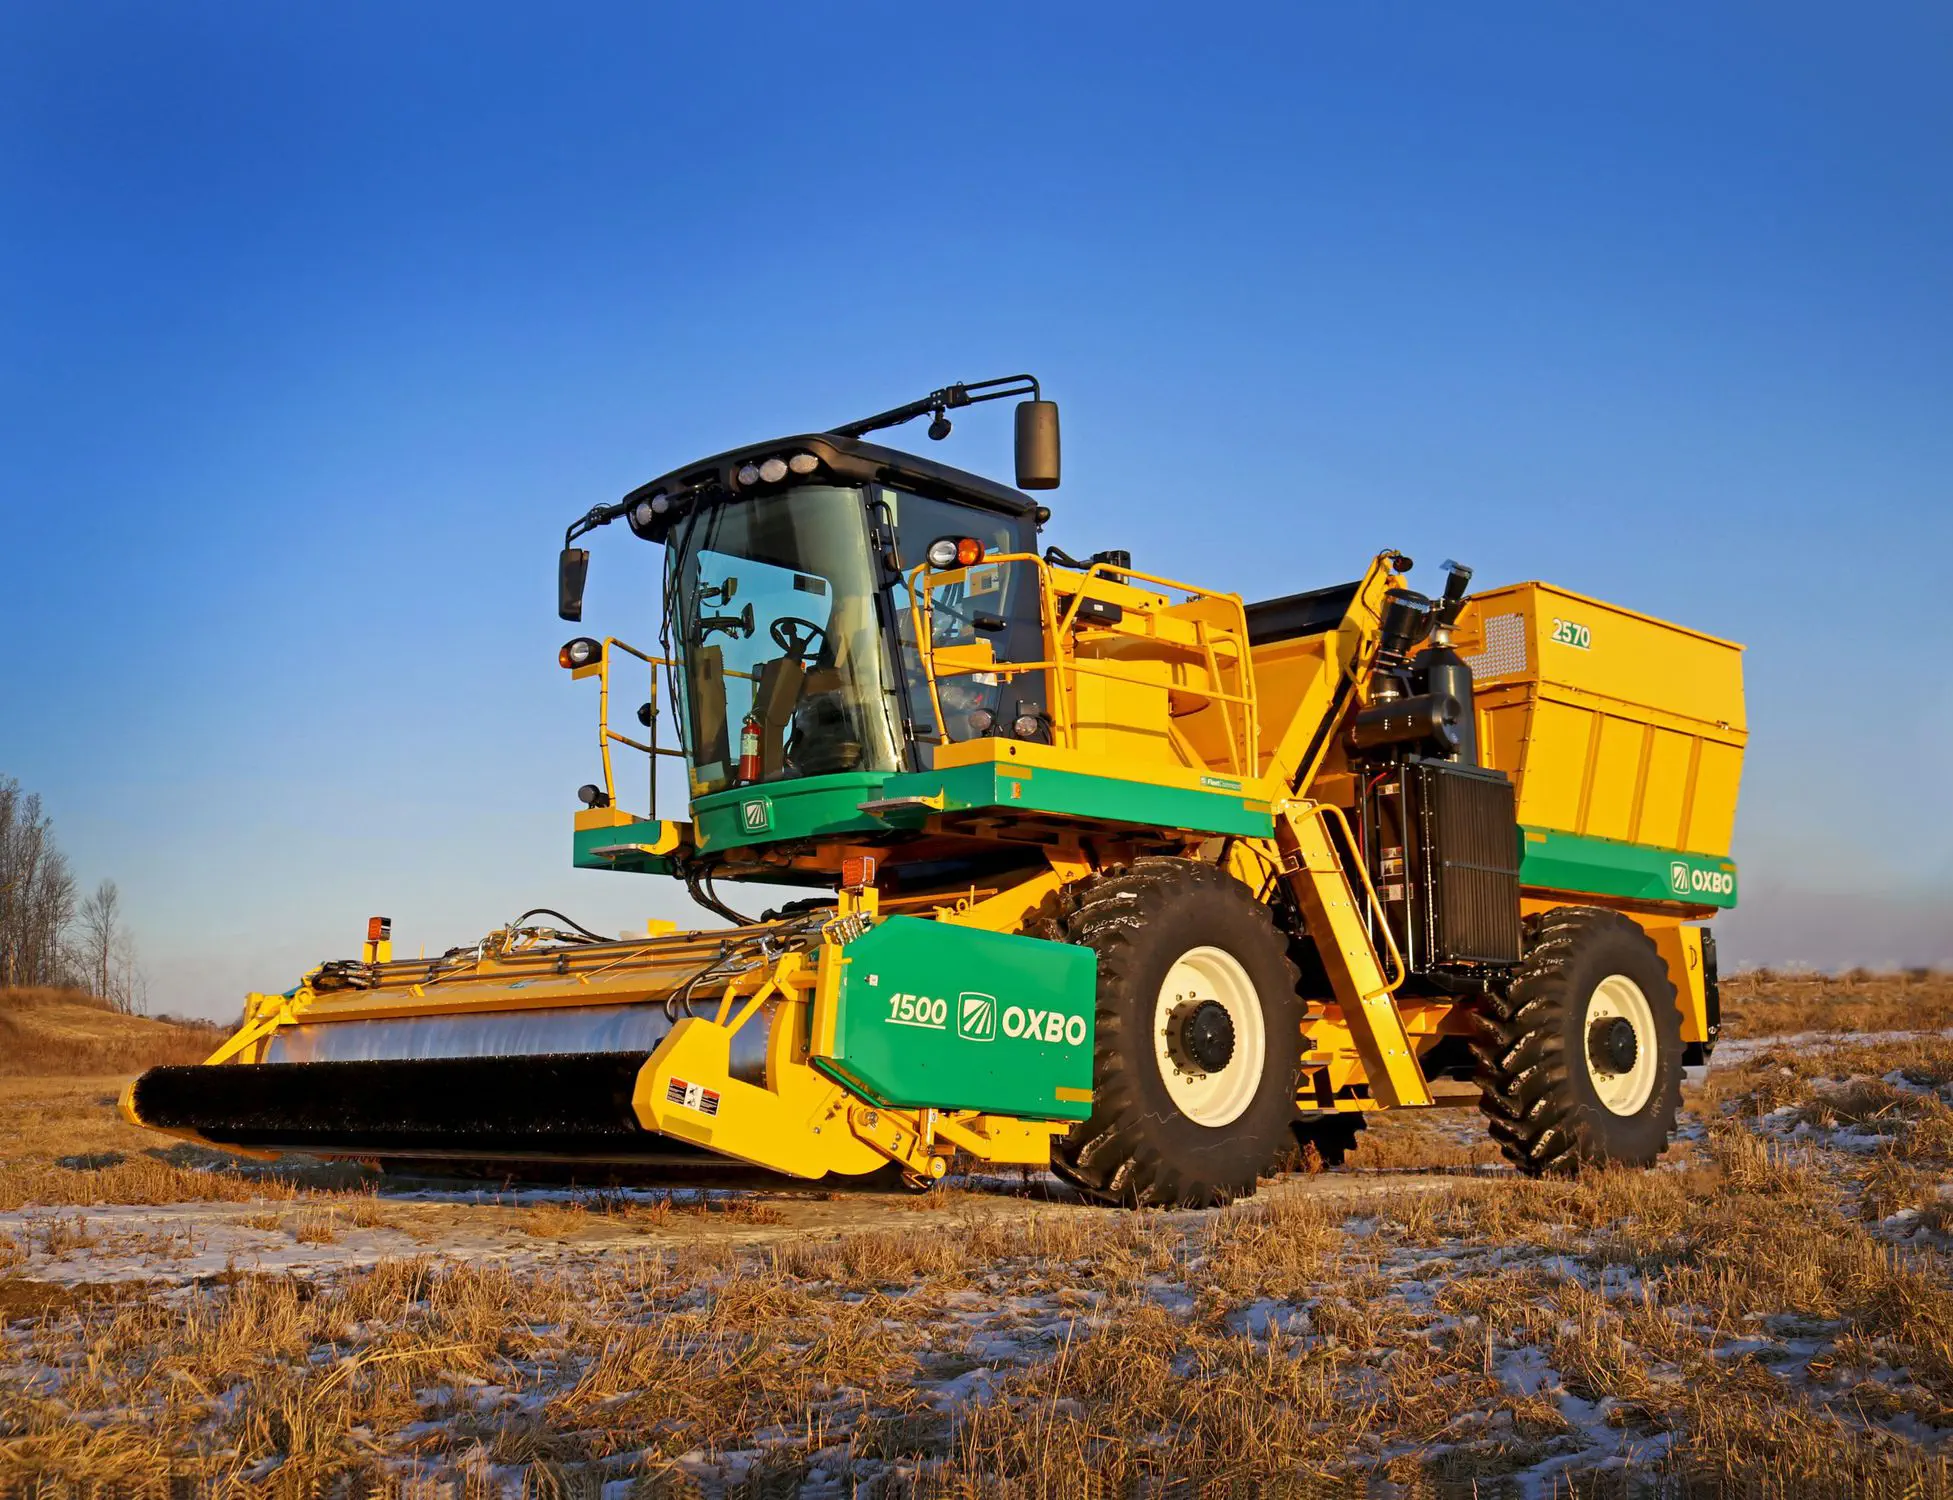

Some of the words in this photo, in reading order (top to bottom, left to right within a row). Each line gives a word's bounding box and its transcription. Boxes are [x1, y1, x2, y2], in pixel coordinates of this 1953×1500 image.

[1552, 617, 1591, 647] 2570
[1691, 869, 1733, 895] OXBO
[889, 993, 948, 1025] 1500
[1002, 1005, 1087, 1046] OXBO
